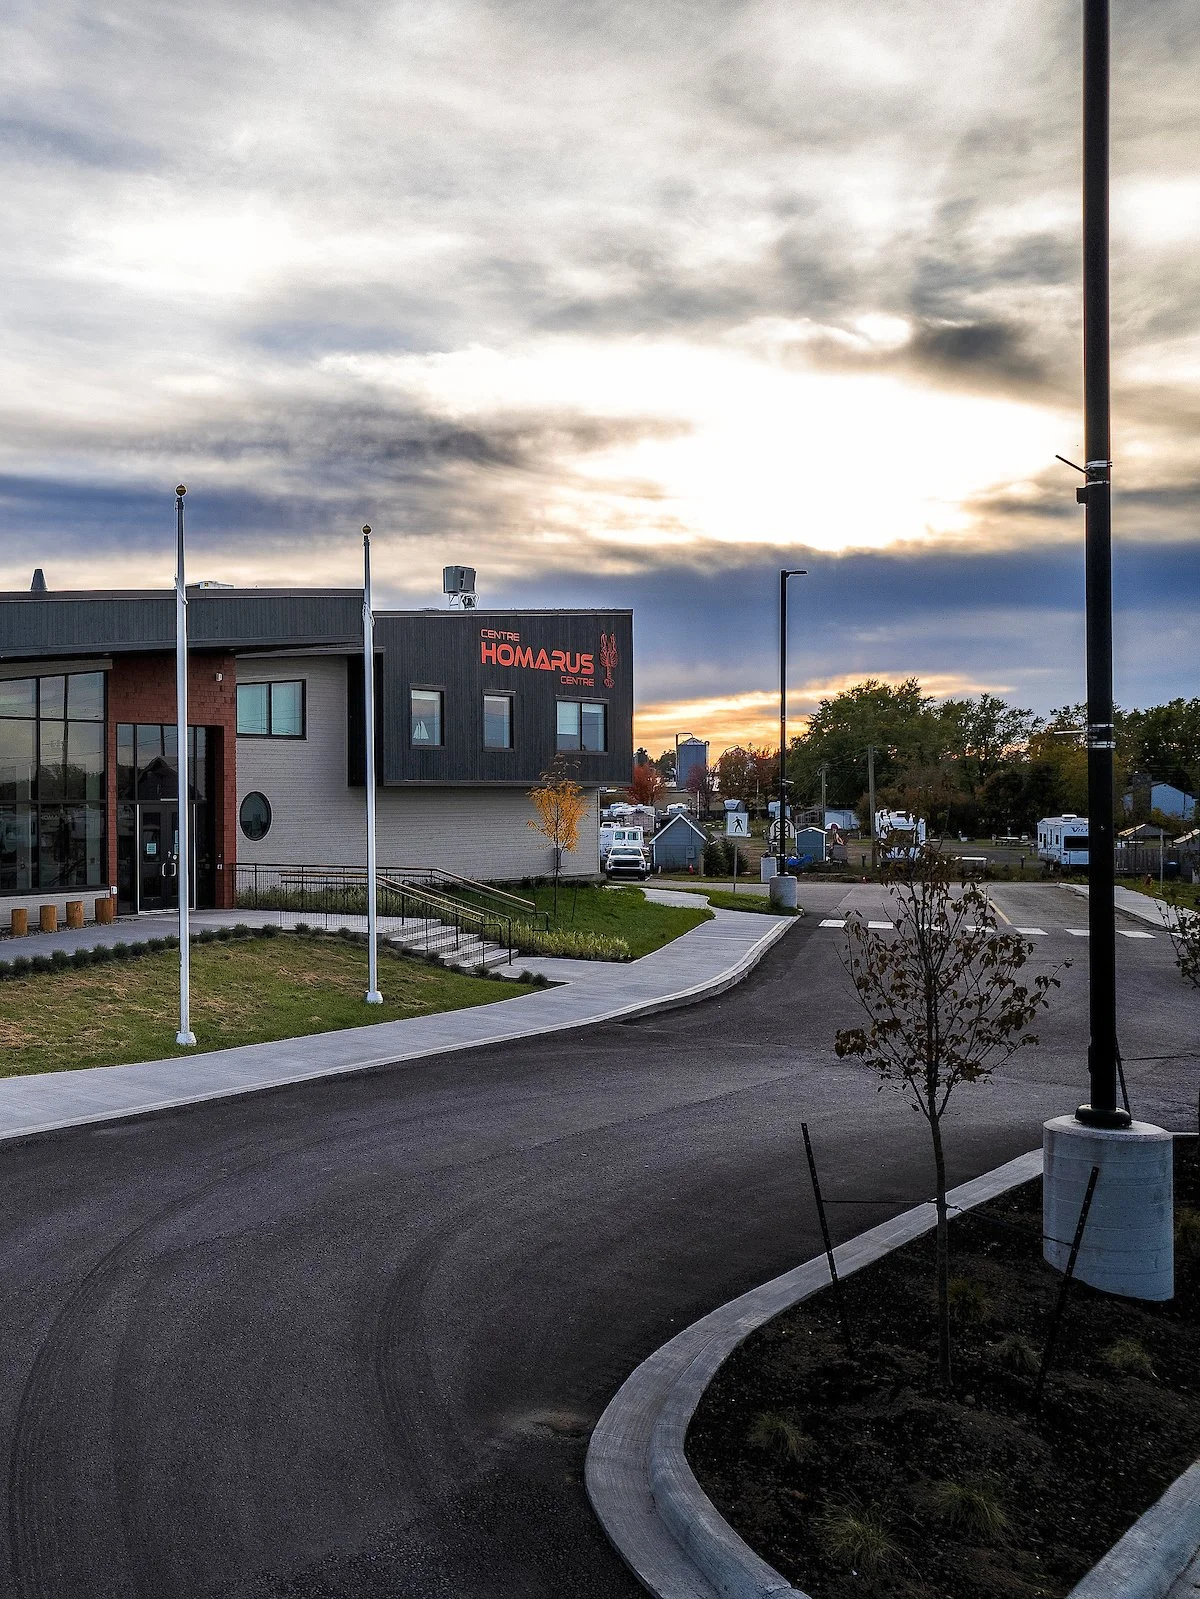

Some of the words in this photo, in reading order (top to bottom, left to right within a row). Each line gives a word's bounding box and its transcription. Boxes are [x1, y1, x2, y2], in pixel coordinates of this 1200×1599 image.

[481, 629, 520, 642] CENTRE
[481, 642, 594, 674] HOMARUS
[560, 676, 595, 687] CENTRE
